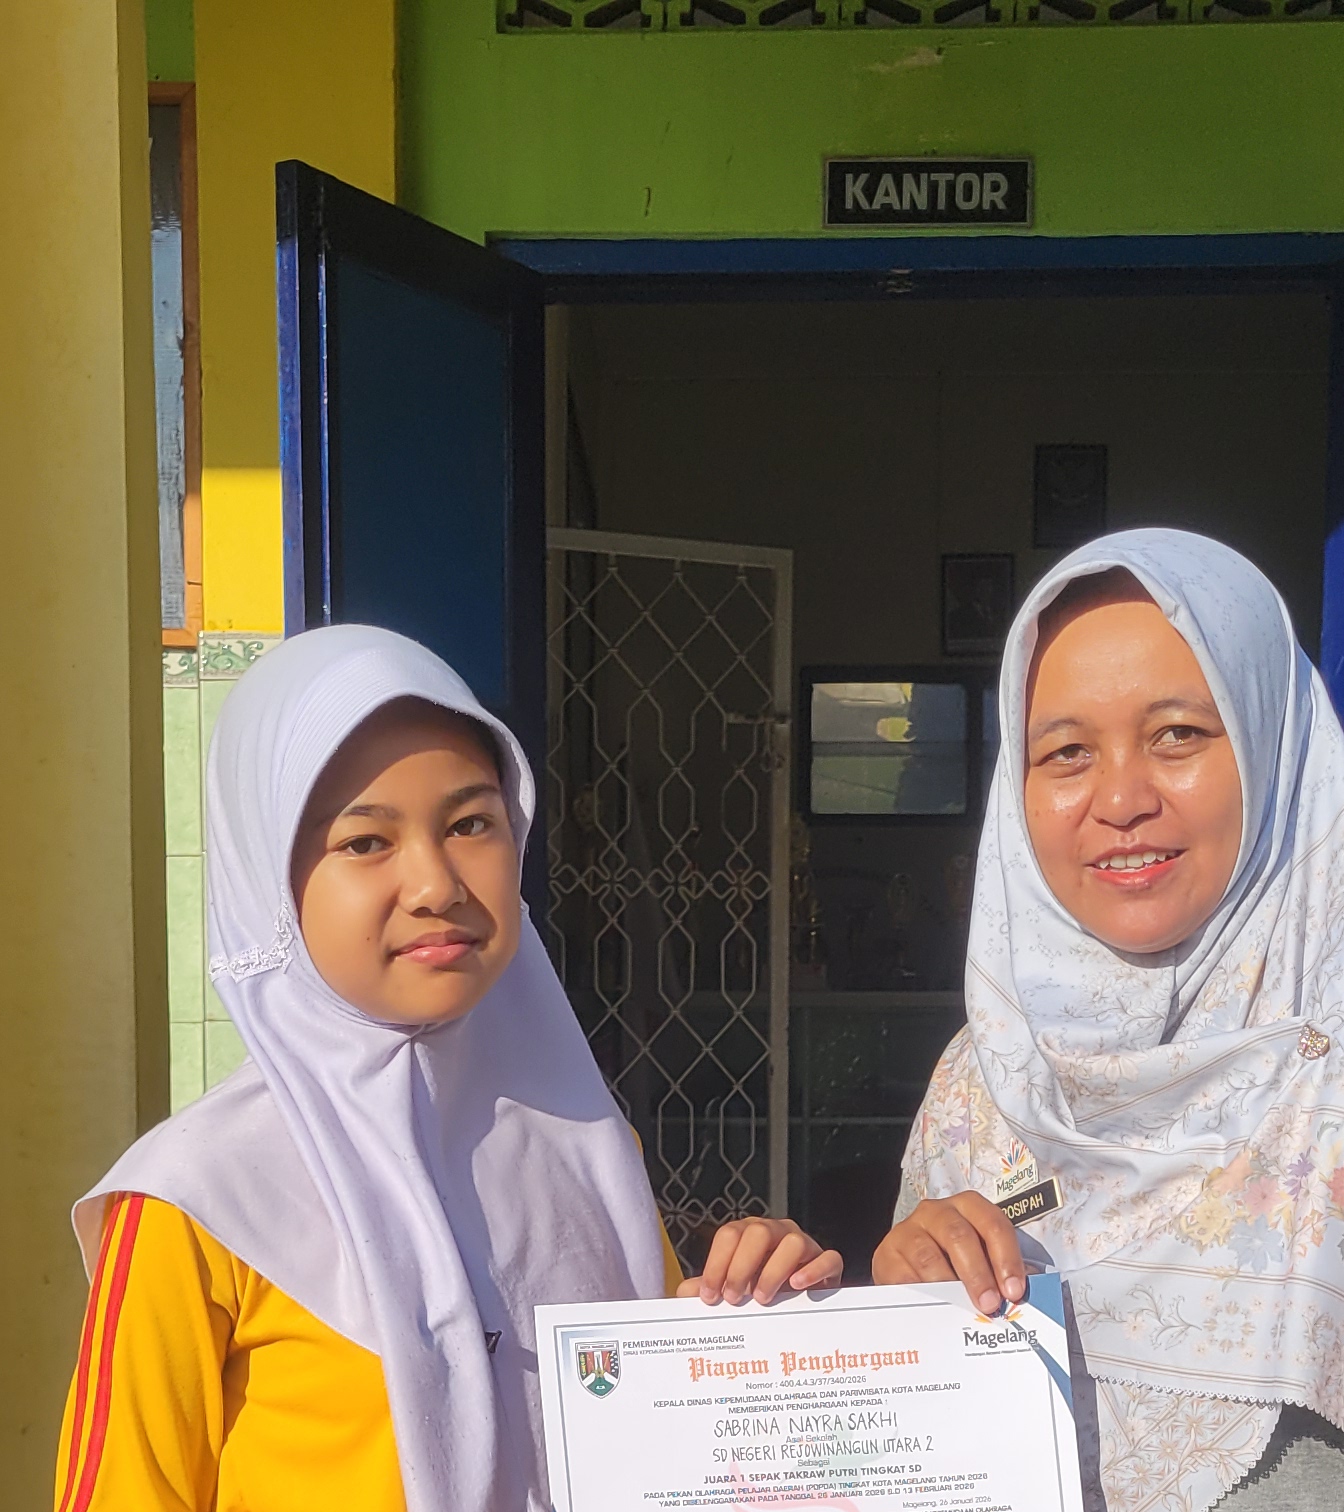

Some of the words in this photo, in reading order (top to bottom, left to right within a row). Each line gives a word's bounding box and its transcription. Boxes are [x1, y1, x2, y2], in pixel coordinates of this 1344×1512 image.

[845, 173, 1008, 210] KANTOR
[997, 1164, 1033, 1195] Magelang
[623, 1340, 674, 1349] PEMERINTAH
[676, 1338, 697, 1346] KOTA
[698, 1335, 745, 1344] MAGELANG
[963, 1328, 1037, 1348] Magelang
[688, 1357, 770, 1382] Piagam
[780, 1349, 920, 1376] Penghargaan
[653, 1400, 685, 1408] KEPALA
[687, 1398, 713, 1406] DINAS
[714, 1395, 772, 1405] KEPEMUDAAN
[774, 1391, 817, 1401] OLAHRAGA
[819, 1390, 838, 1398] DAN
[839, 1388, 890, 1397] PARIWISATA
[891, 1386, 913, 1394] KOTA
[915, 1382, 961, 1392] MAGELANG
[746, 1382, 773, 1390] Nomor
[728, 1404, 784, 1414] MEMBERIKAN
[786, 1400, 848, 1411] PENGHARGAAN
[850, 1398, 883, 1407] KEPADA
[714, 1417, 781, 1438] SABRINA
[789, 1414, 844, 1433] NAYRA
[847, 1411, 898, 1431] SAKHI
[712, 1448, 728, 1463] SD
[731, 1445, 776, 1462] NEGERI
[780, 1438, 879, 1460] REJOWINANGUN
[883, 1437, 922, 1453] UTARA
[925, 1435, 934, 1451] 2
[785, 1435, 804, 1443] Asal
[805, 1433, 838, 1442] Sekolah
[704, 1475, 737, 1484] JUARA
[749, 1472, 781, 1482] SEPAK
[783, 1470, 826, 1480] TAKRAW
[829, 1468, 858, 1477] PUTRI
[861, 1465, 906, 1476] TINGKAT
[909, 1464, 922, 1473] SD
[798, 1458, 831, 1468] Sebagai
[644, 1491, 666, 1499] PADA
[667, 1490, 693, 1498] PEKAN
[695, 1488, 736, 1497] OLAHRAGA
[738, 1486, 771, 1495] PELAJAR
[773, 1484, 804, 1493] DAERAH
[839, 1480, 870, 1489] TINGKAT
[872, 1479, 893, 1487] KOTA
[894, 1477, 937, 1486] MAGELANG
[938, 1475, 966, 1483] TAHUN
[659, 1500, 680, 1508] YANG
[683, 1496, 756, 1506] DISELENGGARAKAN
[758, 1494, 779, 1503] PADA
[780, 1492, 816, 1501] TANGGAL
[829, 1490, 863, 1499] JANUARI
[915, 1484, 953, 1494] FEBRUARI
[975, 1496, 992, 1504] 2026
